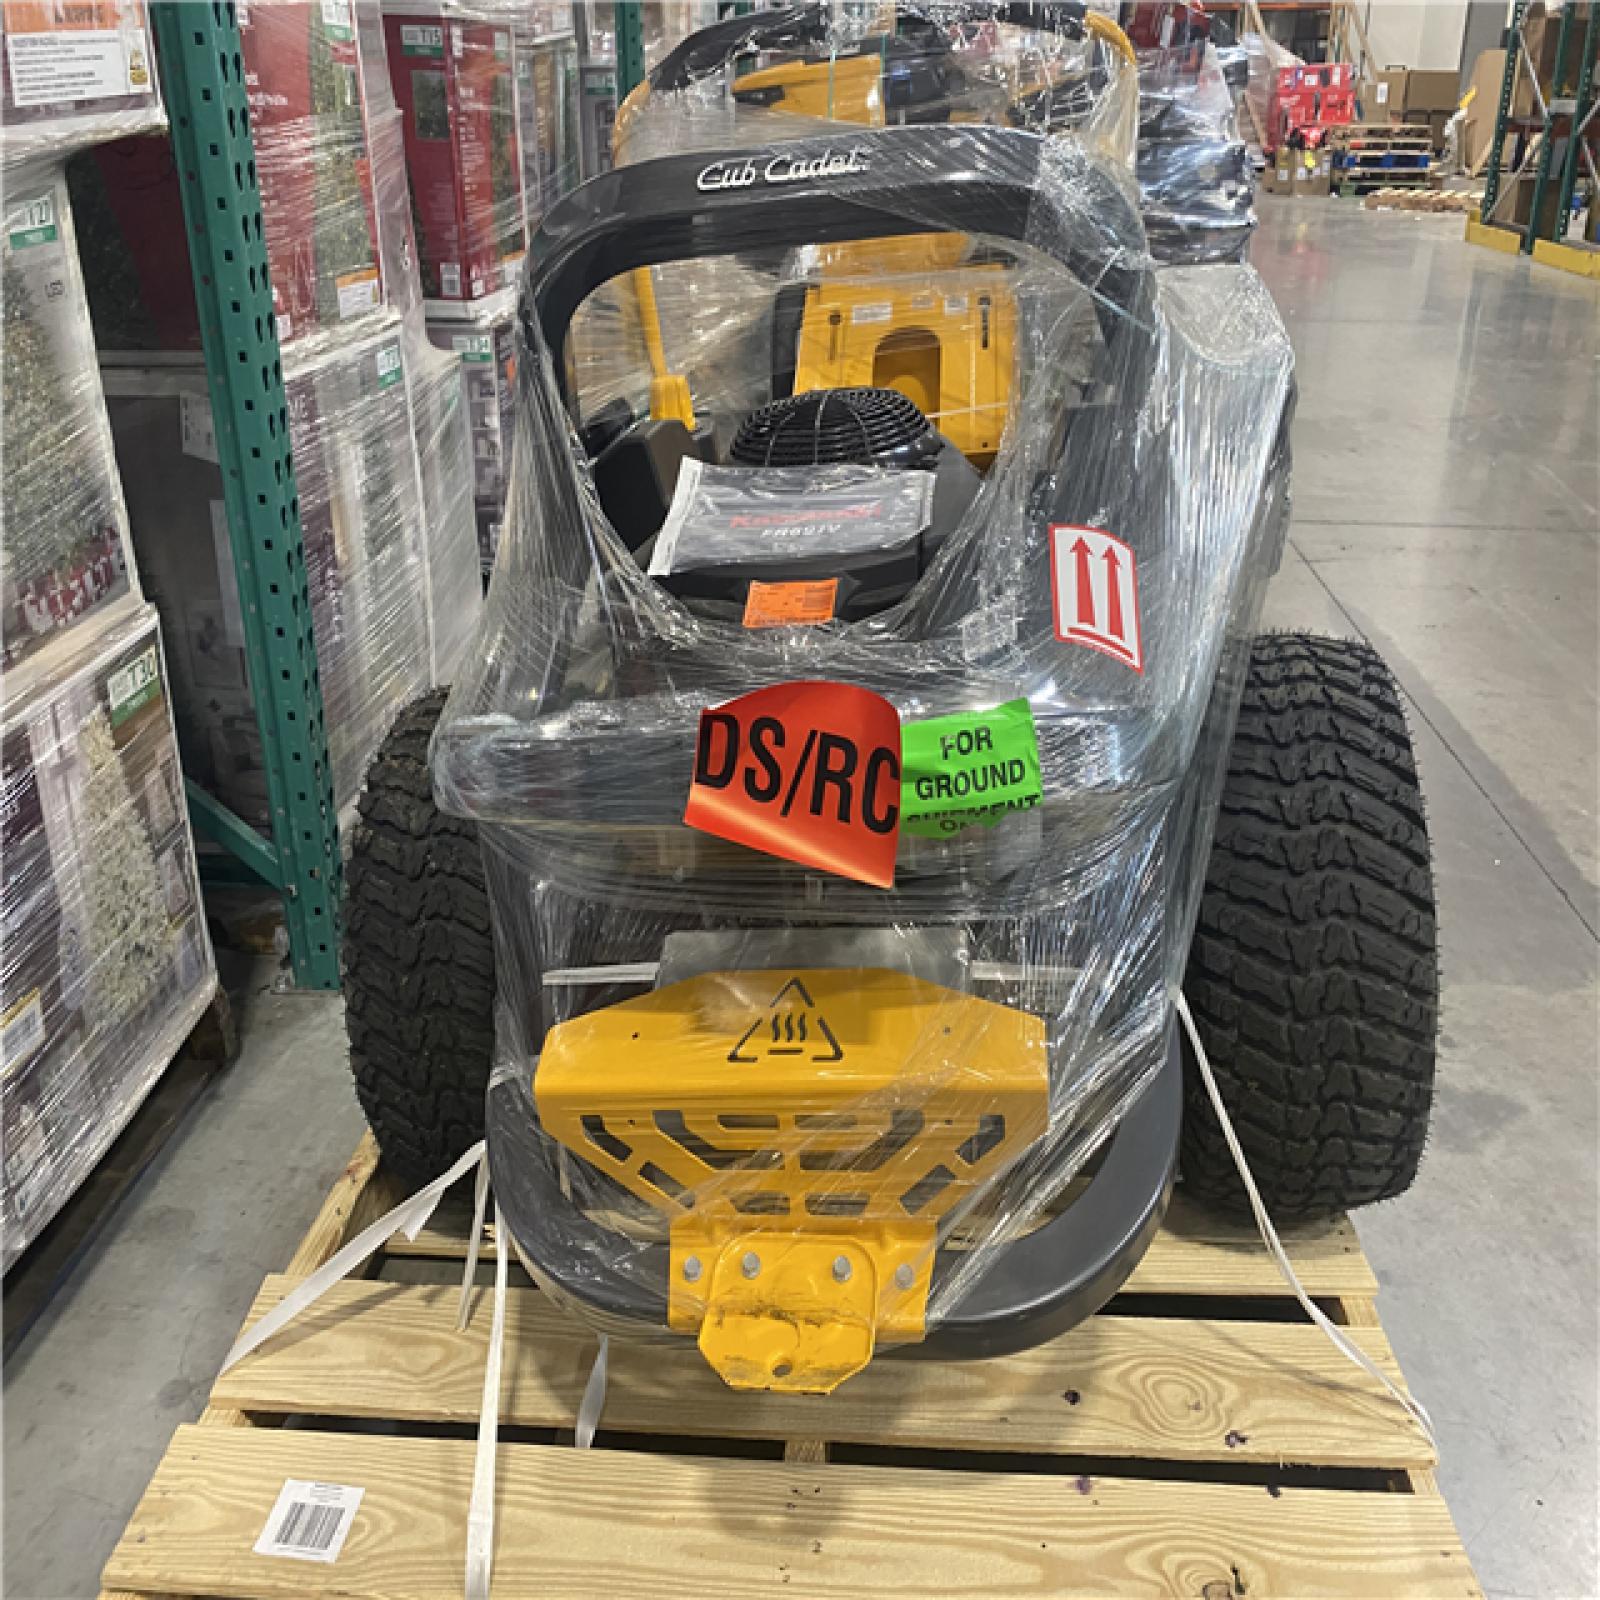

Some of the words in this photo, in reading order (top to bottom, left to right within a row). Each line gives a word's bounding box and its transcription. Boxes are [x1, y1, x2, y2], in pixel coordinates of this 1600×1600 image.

[697, 158, 756, 191] Cub
[940, 726, 993, 760] FOR
[694, 713, 900, 835] DS/RC
[915, 759, 1026, 800] GROUND
